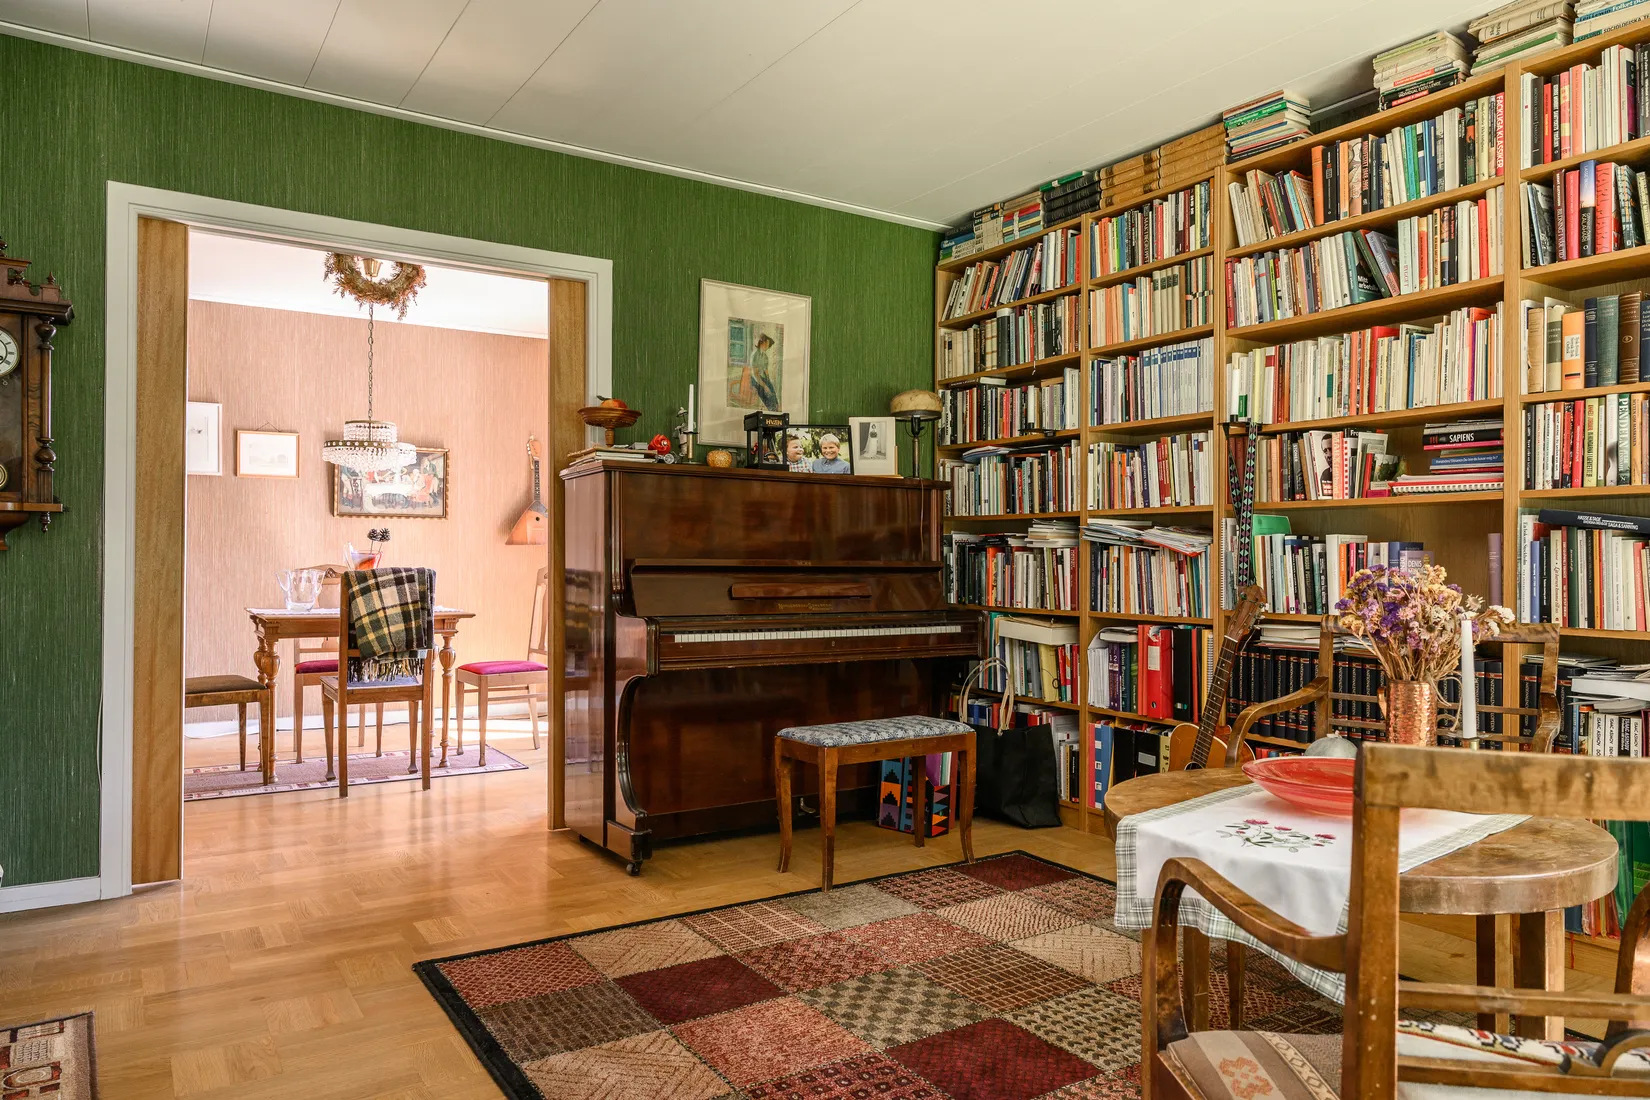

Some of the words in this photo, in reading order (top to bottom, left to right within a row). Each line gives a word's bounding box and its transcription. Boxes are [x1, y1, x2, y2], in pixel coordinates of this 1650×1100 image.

[1612, 1, 1633, 12] Folket
[1603, 17, 1642, 34] SOCIOLOGISKA
[1596, 168, 1610, 206] KARL
[1619, 398, 1629, 447] PENDELN
[1449, 433, 1475, 443] SAPIENS
